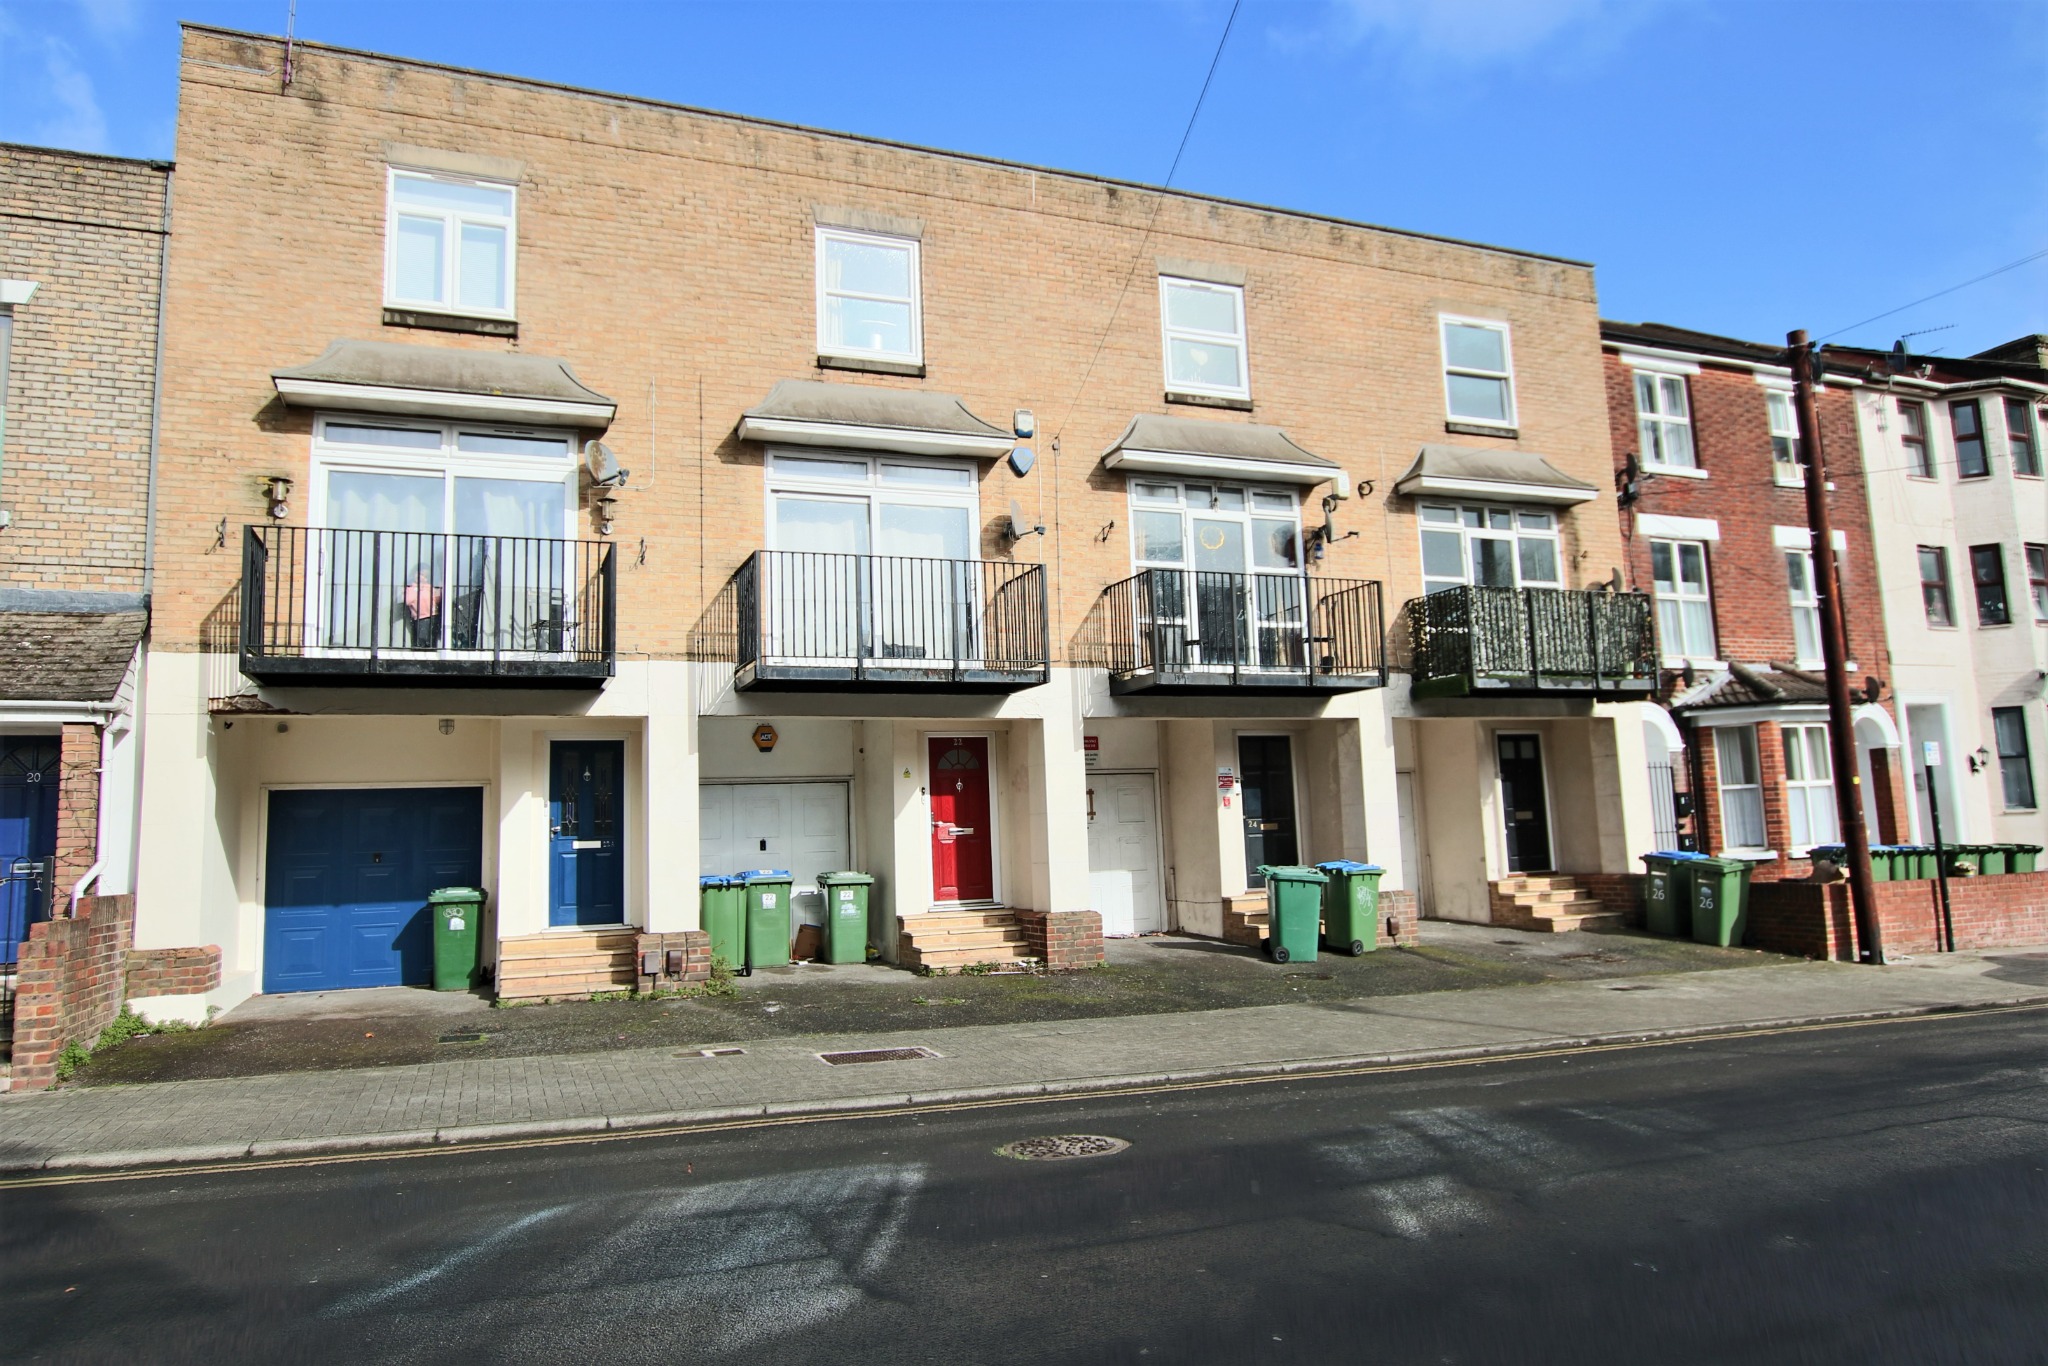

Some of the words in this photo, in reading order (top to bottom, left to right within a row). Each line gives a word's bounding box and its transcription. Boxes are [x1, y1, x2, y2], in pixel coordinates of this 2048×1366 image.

[953, 738, 963, 746] 22
[26, 772, 41, 783] 20
[1248, 820, 1258, 828] 24
[1652, 888, 1665, 900] 26
[1699, 896, 1714, 909] 26
